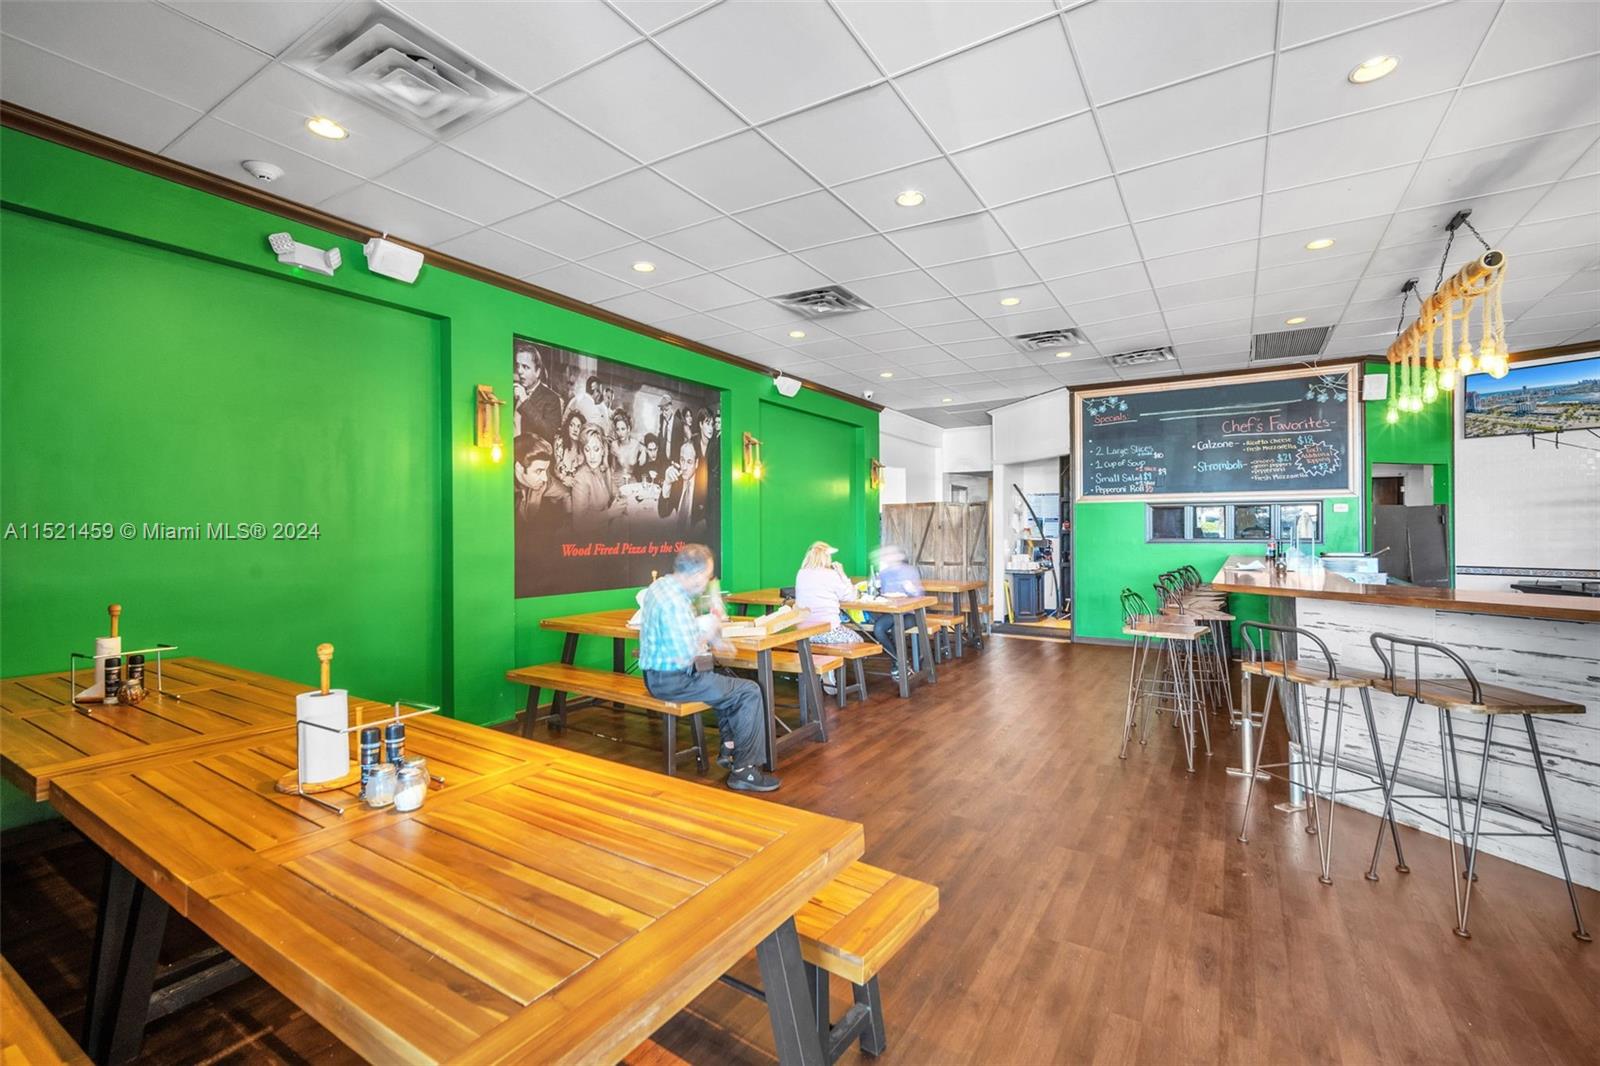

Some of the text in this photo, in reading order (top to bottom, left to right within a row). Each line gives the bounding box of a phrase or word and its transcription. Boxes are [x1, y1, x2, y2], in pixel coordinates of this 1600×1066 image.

[1221, 416, 1264, 433] Chef's
[1297, 435, 1313, 445] $18
[1095, 446, 1104, 456] 2
[1106, 446, 1128, 457] Large
[1276, 453, 1292, 462] $21
[1095, 460, 1103, 469] 1
[1095, 472, 1120, 484] Small
[1121, 472, 1142, 482] Salad
[562, 543, 593, 557] Wood
[593, 542, 621, 556] Fired
[621, 542, 647, 555] Pizza
[647, 542, 659, 557] by
[659, 541, 673, 553] the
